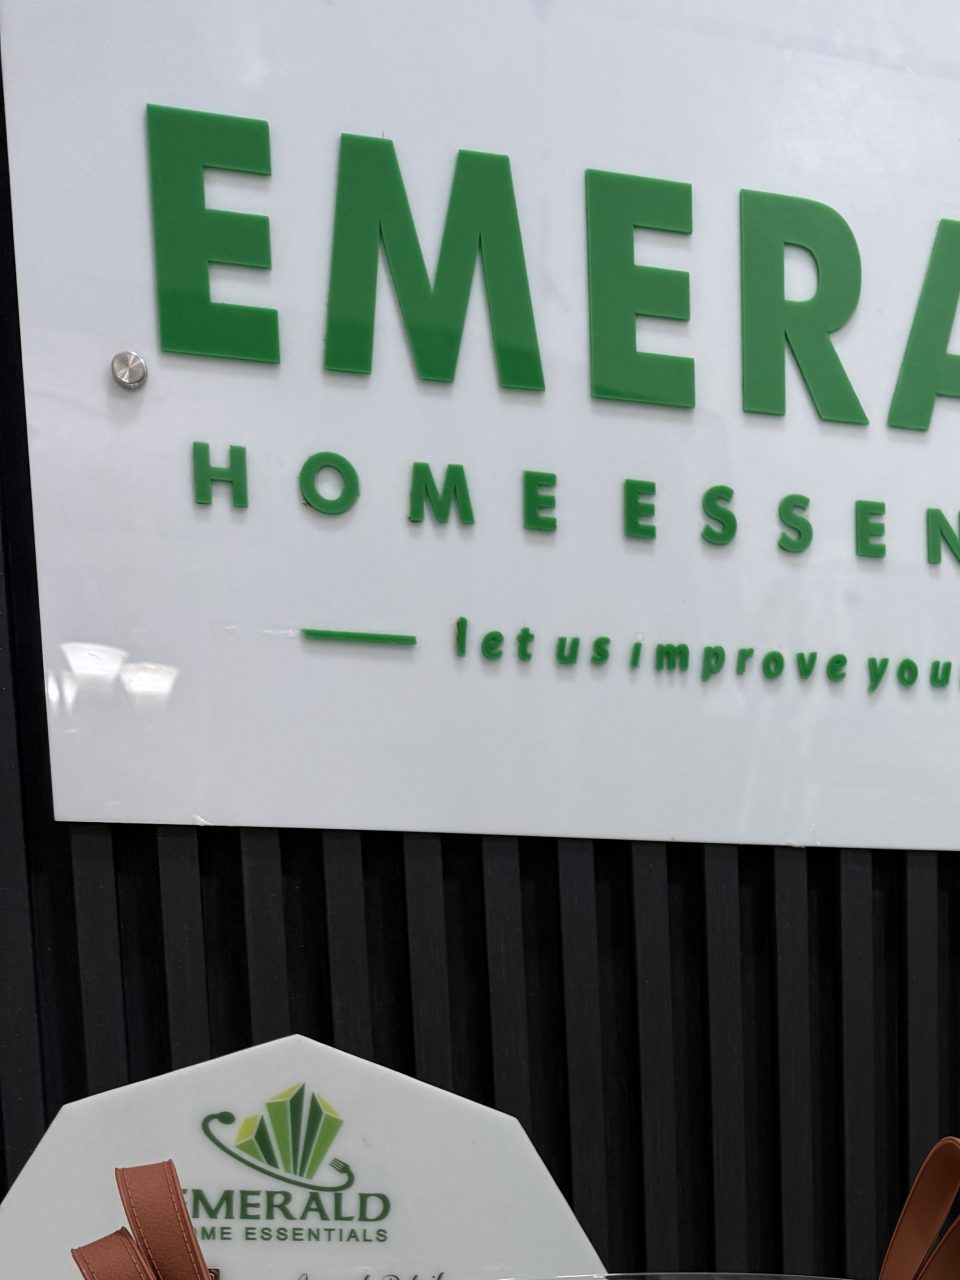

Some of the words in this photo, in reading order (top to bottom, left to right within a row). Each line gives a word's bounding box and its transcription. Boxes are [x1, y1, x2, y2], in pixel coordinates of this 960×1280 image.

[192, 440, 558, 533] HOME
[456, 616, 535, 662] let
[556, 635, 612, 665] us
[630, 641, 848, 683] improve
[182, 1188, 391, 1222] MERALD
[245, 1227, 388, 1243] ESSENTIALS
